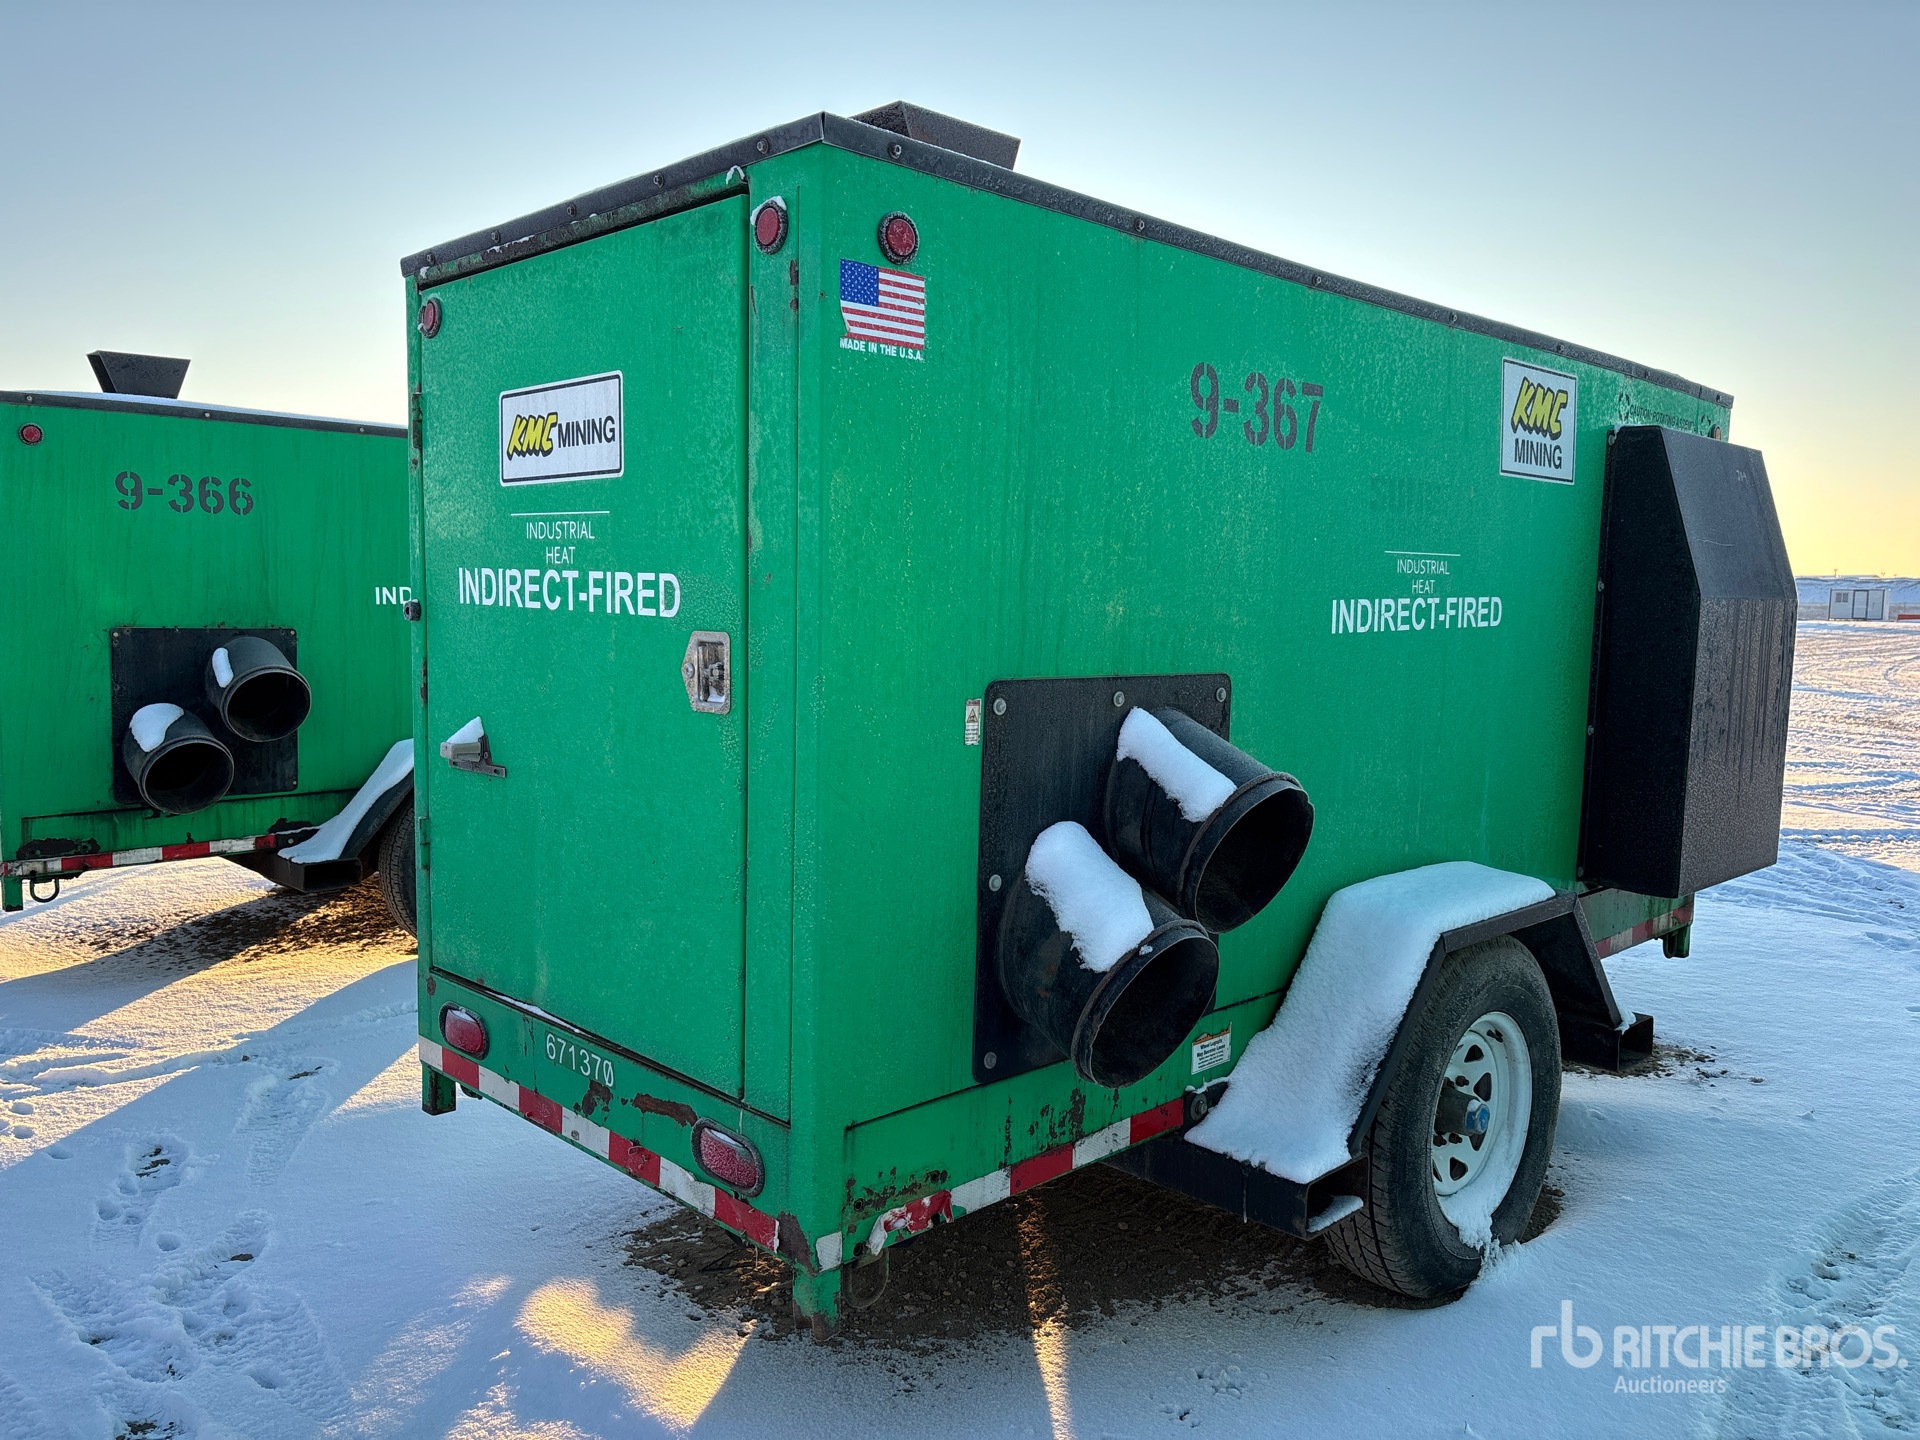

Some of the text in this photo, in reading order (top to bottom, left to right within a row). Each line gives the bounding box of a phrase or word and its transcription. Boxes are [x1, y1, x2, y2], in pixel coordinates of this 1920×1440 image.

[840, 338, 865, 351] MADE
[868, 341, 877, 353] IN
[880, 344, 897, 357] THE
[1191, 361, 1324, 453] 9-367
[1511, 377, 1568, 440] KMC
[507, 411, 616, 461] KMC MINING
[1514, 438, 1562, 470] MINING
[114, 470, 254, 516] 9-366
[526, 521, 595, 541] INDUSTRIAL
[545, 546, 575, 564] HEAT
[1397, 559, 1450, 575] INDUSTRIAL
[458, 567, 681, 618] INDIRECT-FIRED
[1412, 579, 1435, 594] HEAT
[1331, 596, 1503, 634] INDIRECT-FIRED
[546, 1033, 614, 1087] 671370
